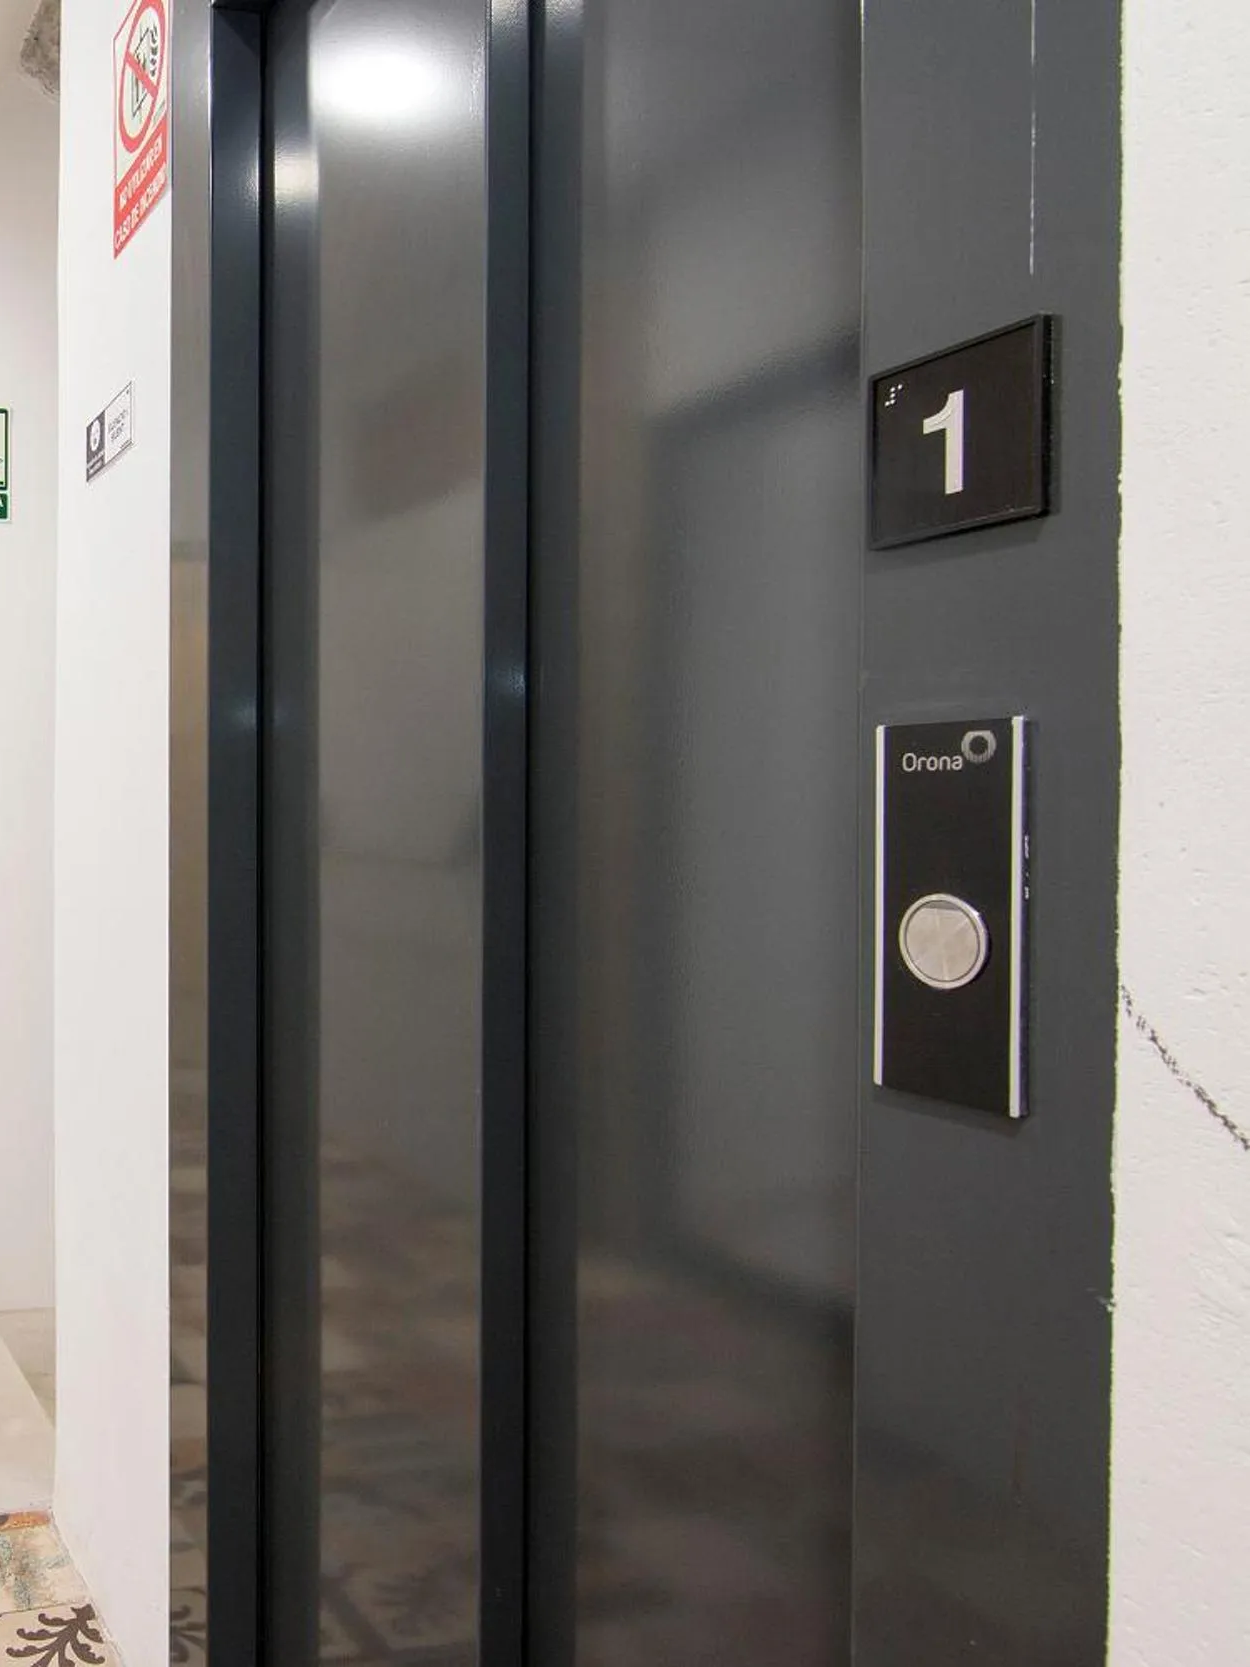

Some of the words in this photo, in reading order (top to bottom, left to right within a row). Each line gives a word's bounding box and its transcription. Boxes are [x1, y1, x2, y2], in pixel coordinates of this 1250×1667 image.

[114, 214, 130, 250] CASO
[922, 389, 964, 495] 1
[902, 752, 963, 772] Orona
